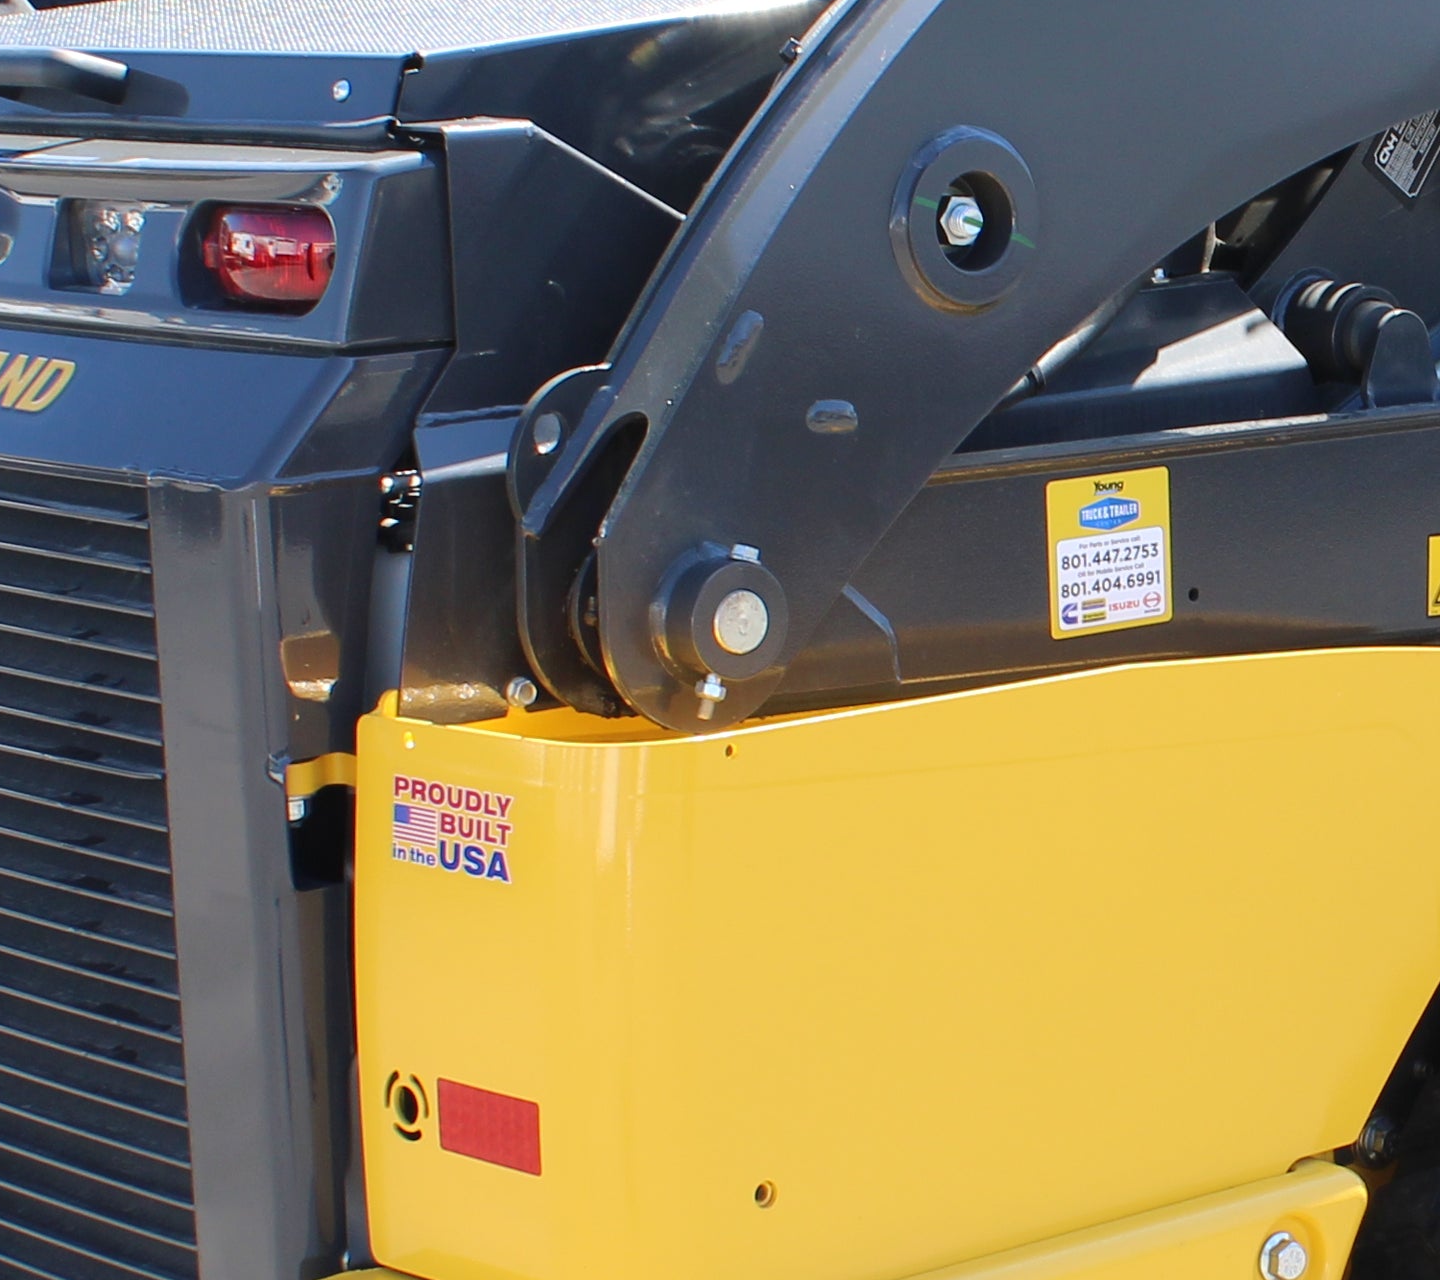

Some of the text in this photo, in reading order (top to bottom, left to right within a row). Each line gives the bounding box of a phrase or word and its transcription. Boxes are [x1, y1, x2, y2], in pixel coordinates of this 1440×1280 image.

[1093, 480, 1124, 493] Young
[1111, 537, 1129, 545] Service
[1061, 542, 1159, 570] 801.447.2753
[1096, 567, 1113, 575] Mobile
[1114, 564, 1133, 572] Service
[1061, 570, 1161, 598] 801.404.6991
[1109, 600, 1140, 611] ISUZU
[394, 776, 511, 818] PROUDLY
[440, 812, 511, 846] BUILT
[393, 840, 509, 882] in the USA
